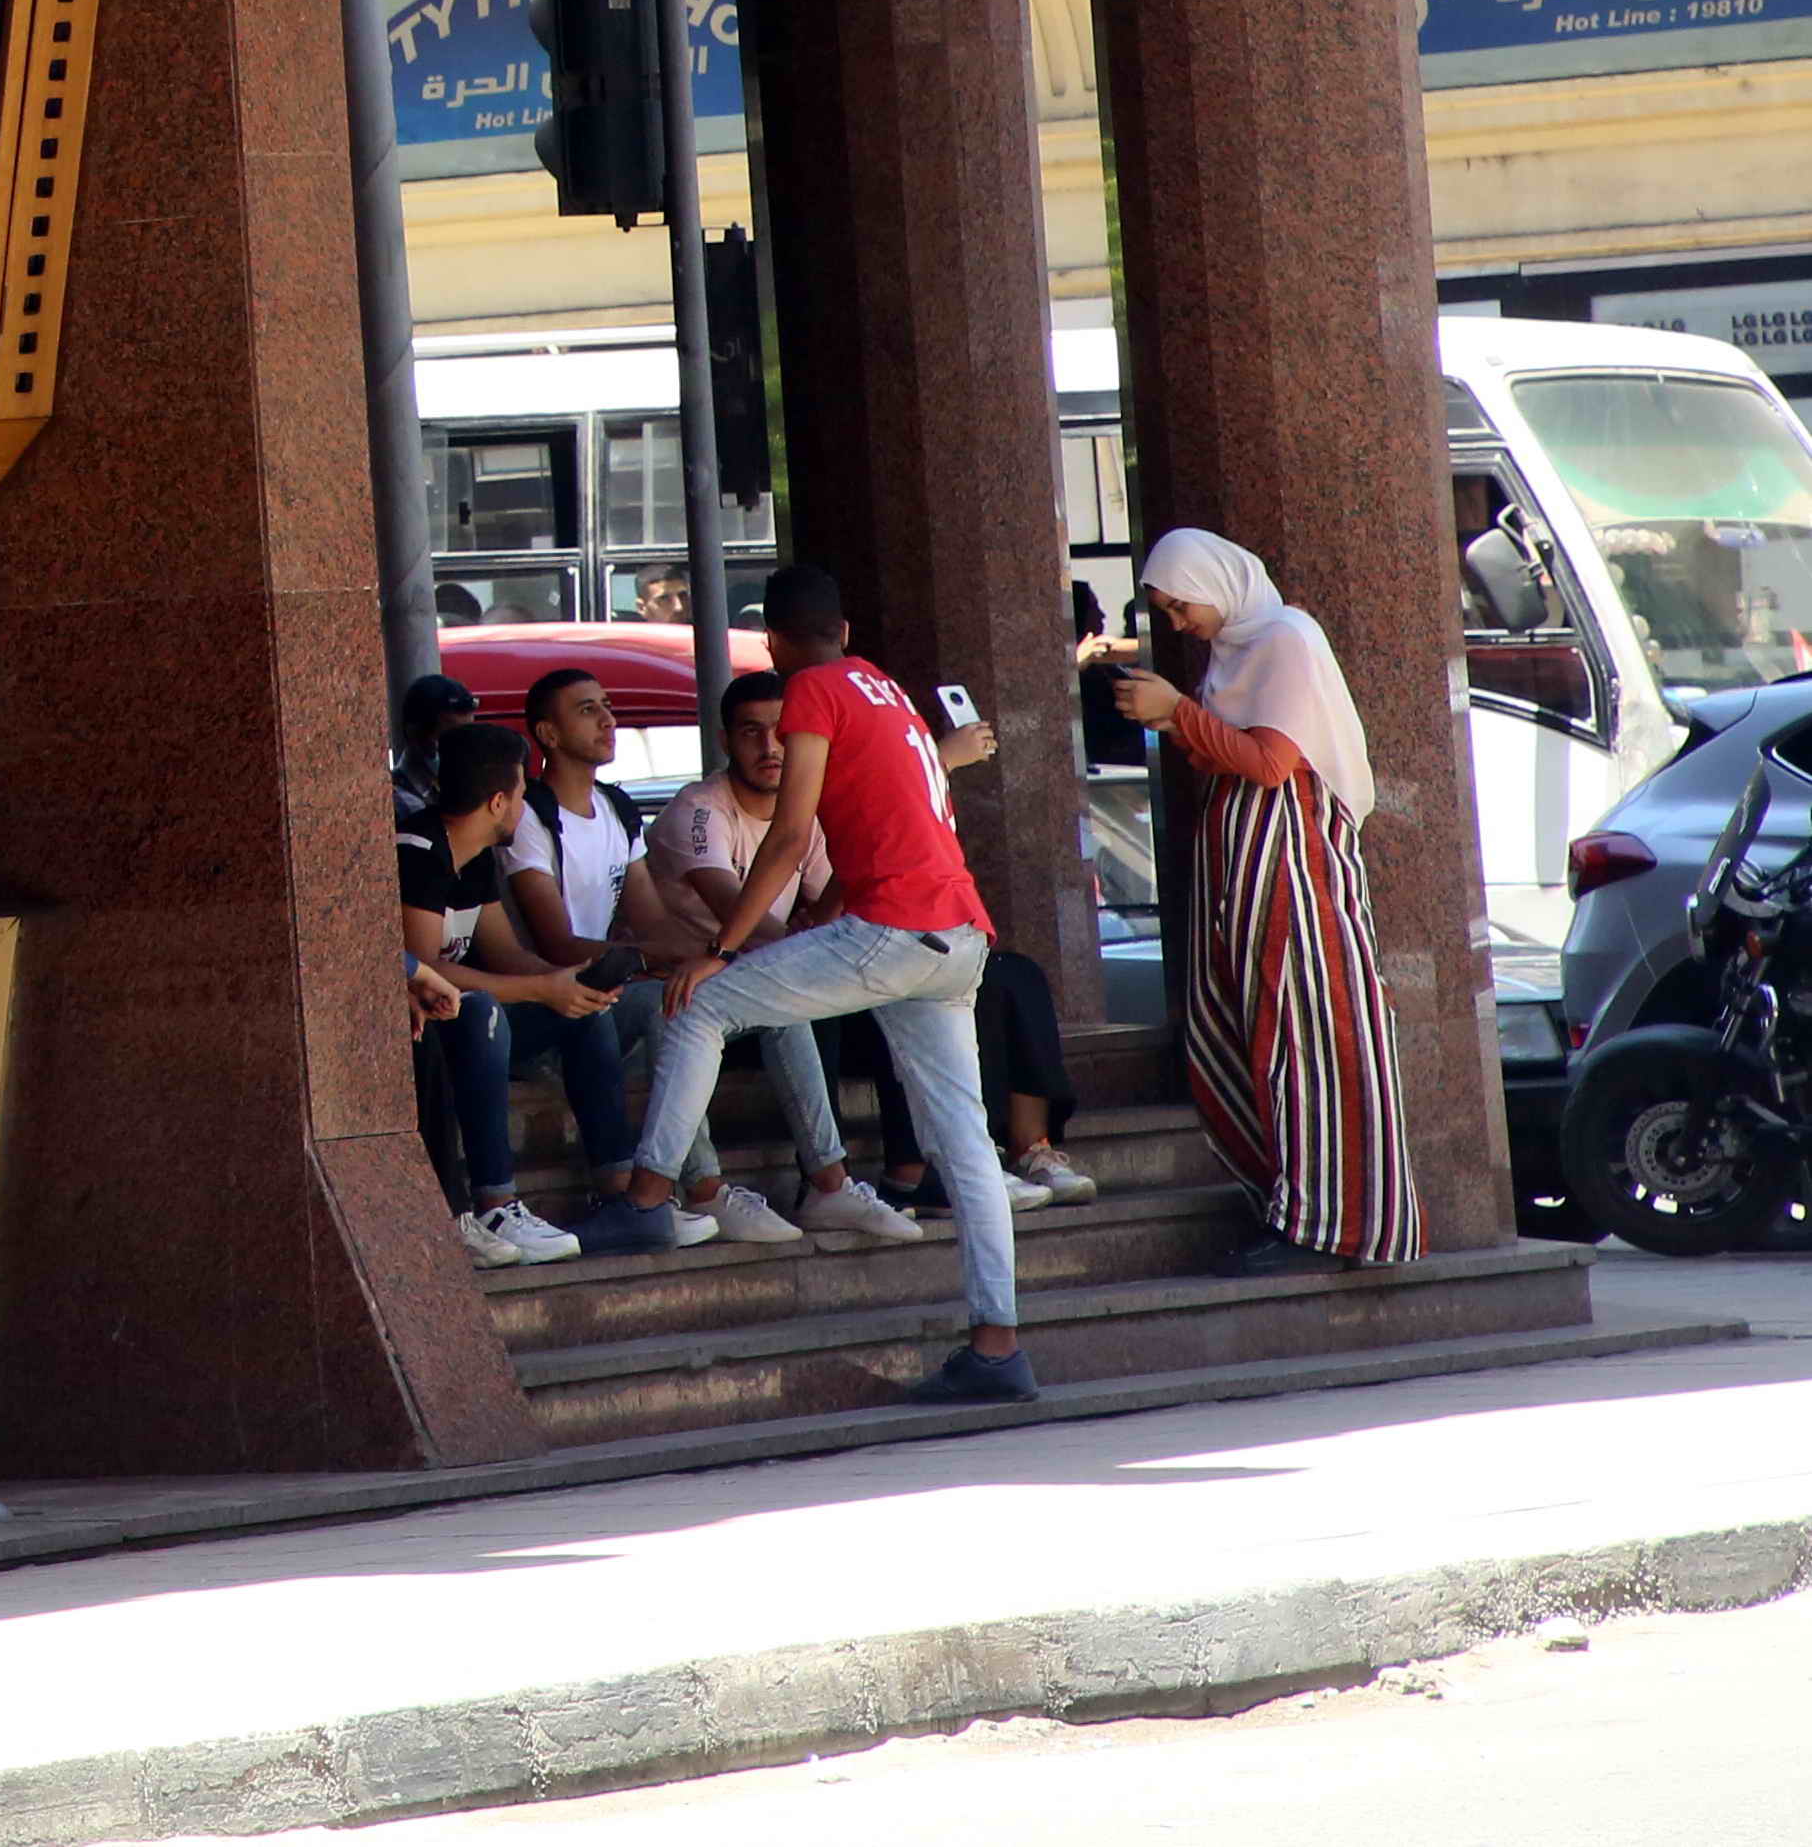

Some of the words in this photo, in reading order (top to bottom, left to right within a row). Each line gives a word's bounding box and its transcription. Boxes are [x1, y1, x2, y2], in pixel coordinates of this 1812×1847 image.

[1555, 10, 1599, 33] Hot
[1607, 5, 1661, 29] Line
[421, 62, 530, 109] الحرة
[475, 109, 515, 130] Hot
[1731, 313, 1758, 330] LG
[1761, 311, 1787, 328] LG
[1731, 331, 1759, 347] LG
[1761, 330, 1787, 346] LG
